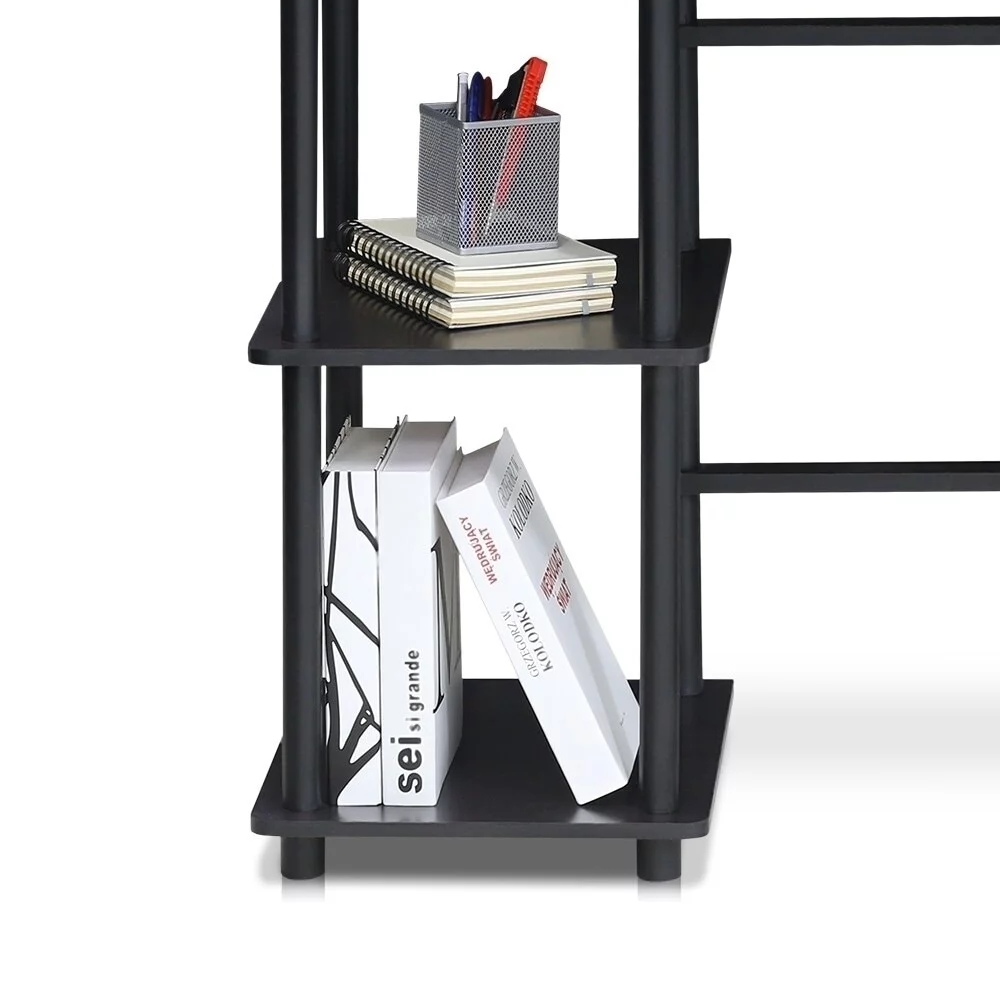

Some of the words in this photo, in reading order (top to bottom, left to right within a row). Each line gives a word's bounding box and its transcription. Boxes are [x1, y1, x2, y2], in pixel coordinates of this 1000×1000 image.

[506, 621, 541, 679] GRZEGORZ
[404, 649, 425, 712] grande
[405, 717, 422, 732] si
[389, 736, 423, 794] sei
